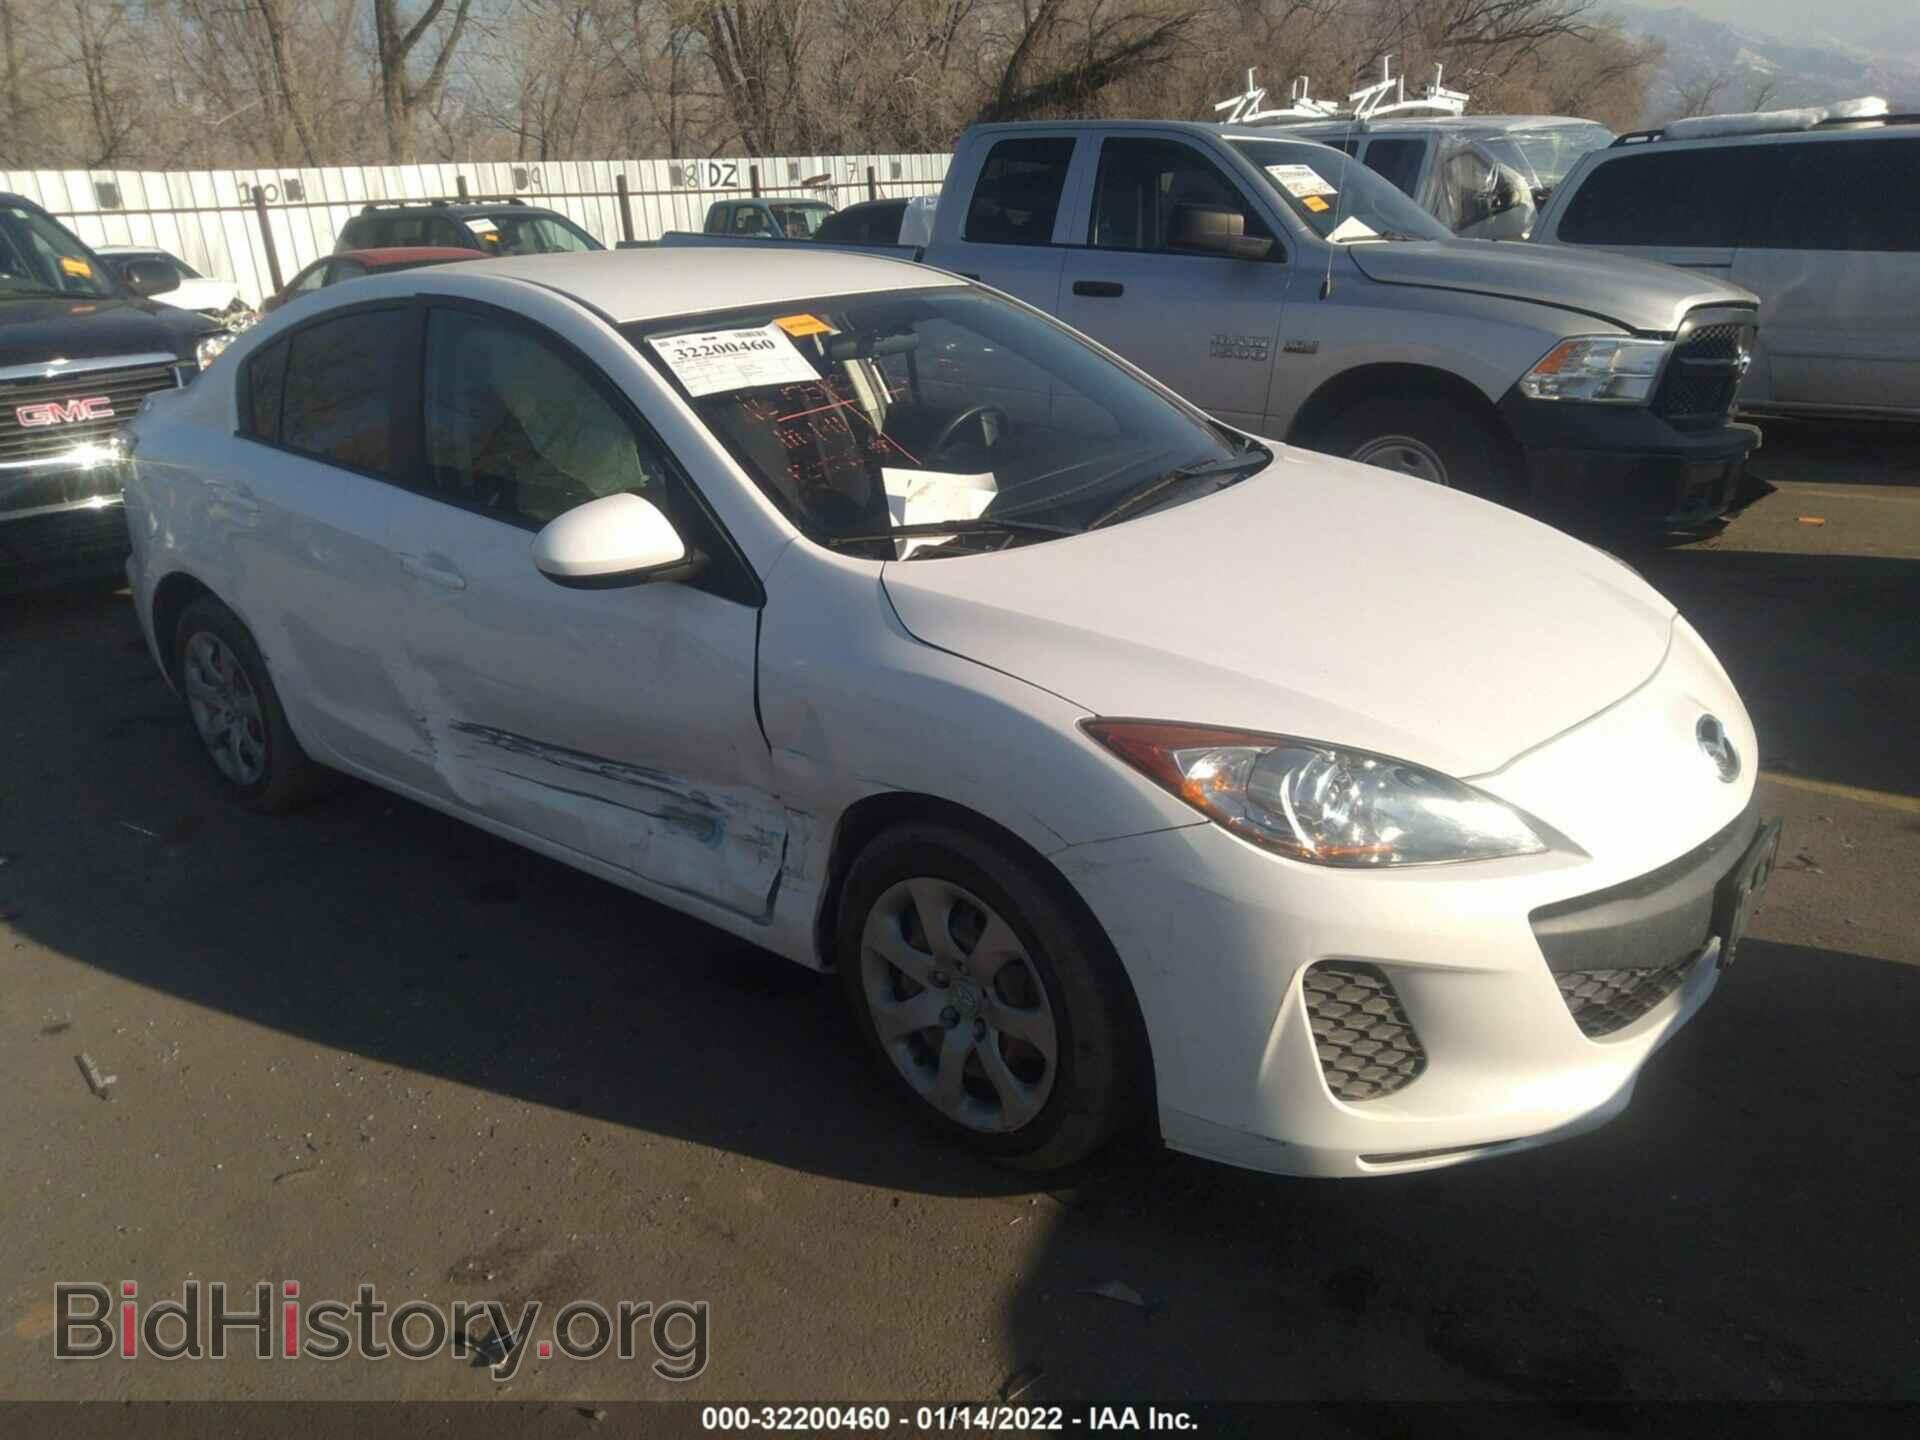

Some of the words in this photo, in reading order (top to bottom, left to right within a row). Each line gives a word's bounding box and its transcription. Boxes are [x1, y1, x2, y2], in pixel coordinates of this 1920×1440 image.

[685, 164, 697, 188] 8
[709, 162, 737, 187] DZ
[673, 339, 776, 361] 32200460
[16, 396, 115, 428] GMC
